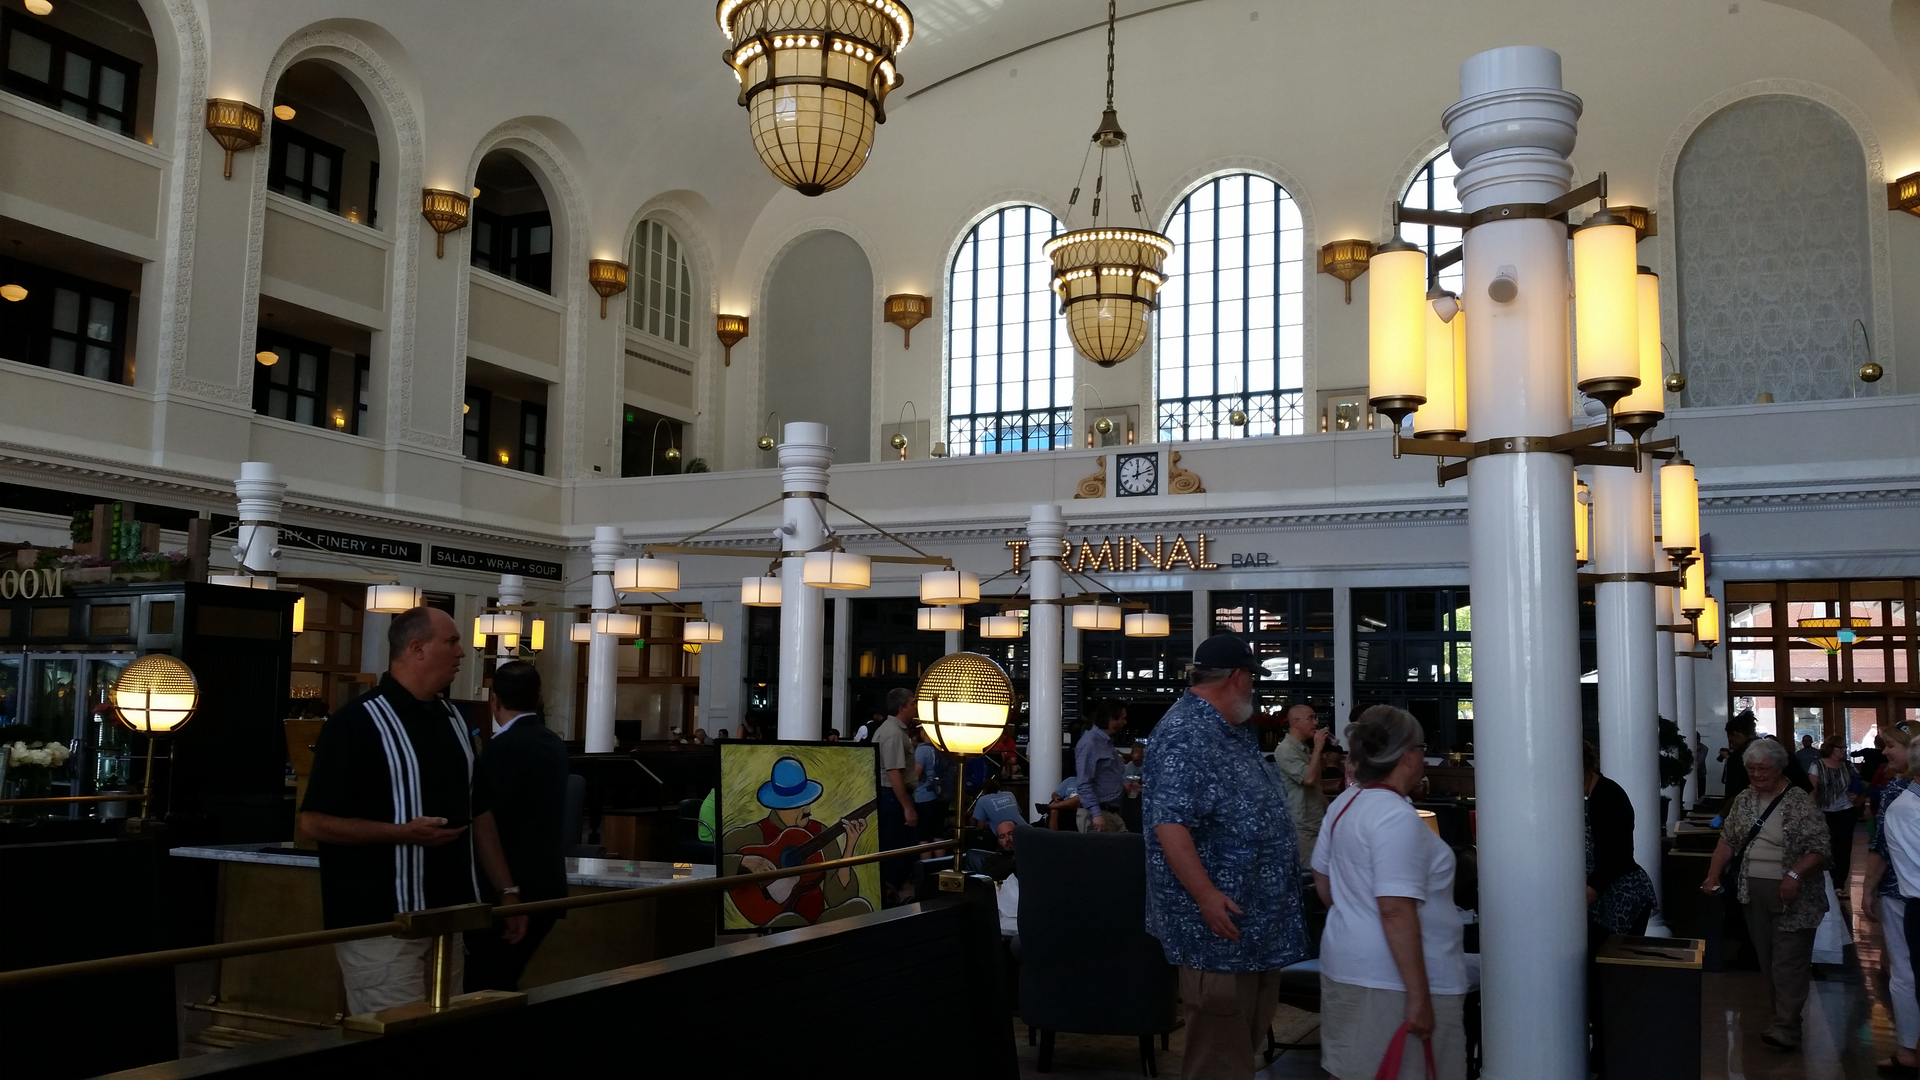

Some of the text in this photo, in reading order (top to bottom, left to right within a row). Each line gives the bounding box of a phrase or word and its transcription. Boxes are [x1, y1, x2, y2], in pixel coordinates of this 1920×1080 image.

[317, 534, 368, 552] FINERY
[381, 543, 409, 557] FUN
[1005, 532, 1269, 575] TRMINAL BAR
[437, 550, 558, 577] SALAD WRAP SOUP
